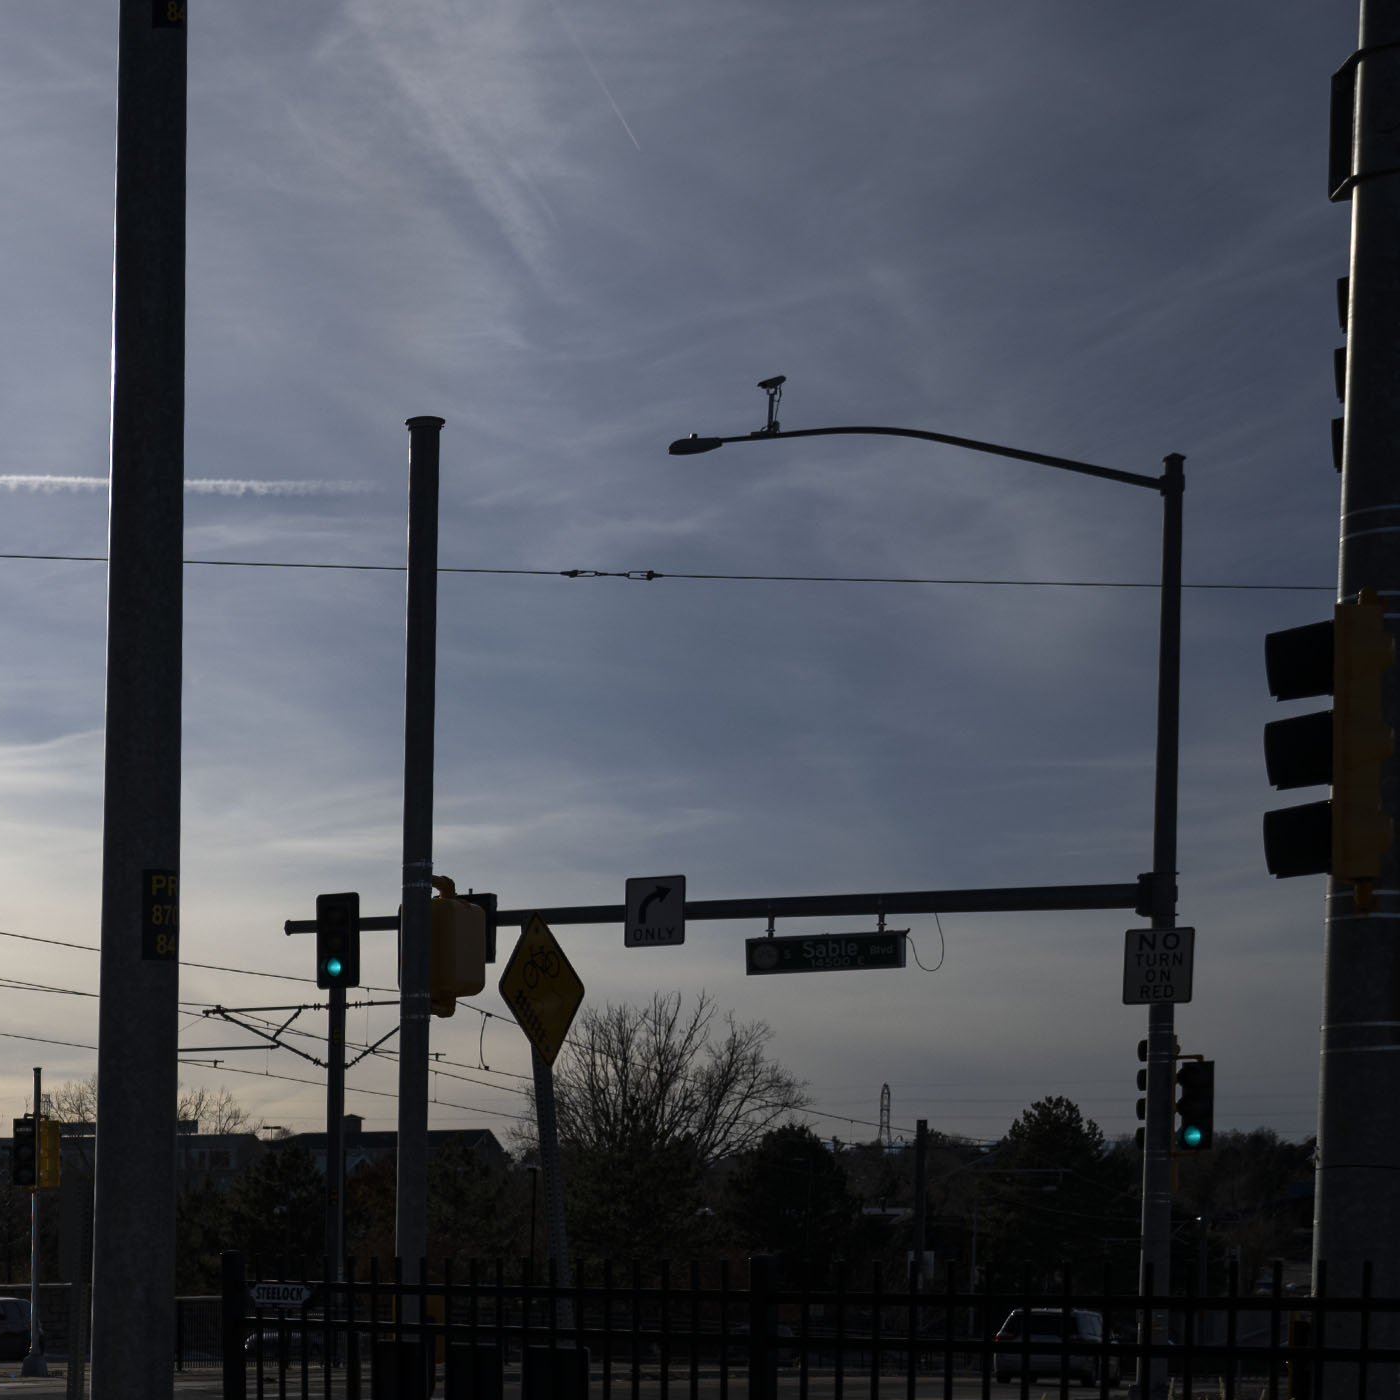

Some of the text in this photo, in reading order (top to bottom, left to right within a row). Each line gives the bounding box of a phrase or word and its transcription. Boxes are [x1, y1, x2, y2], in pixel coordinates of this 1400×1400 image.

[633, 928, 675, 941] ONLY
[1139, 933, 1180, 951] NO
[783, 939, 894, 960] S Sable Blvd
[811, 955, 865, 968] 14500 E
[1136, 952, 1183, 968] TURN
[1145, 969, 1170, 983] ON
[1140, 984, 1174, 999] RED
[256, 1287, 304, 1301] STEELOCK
